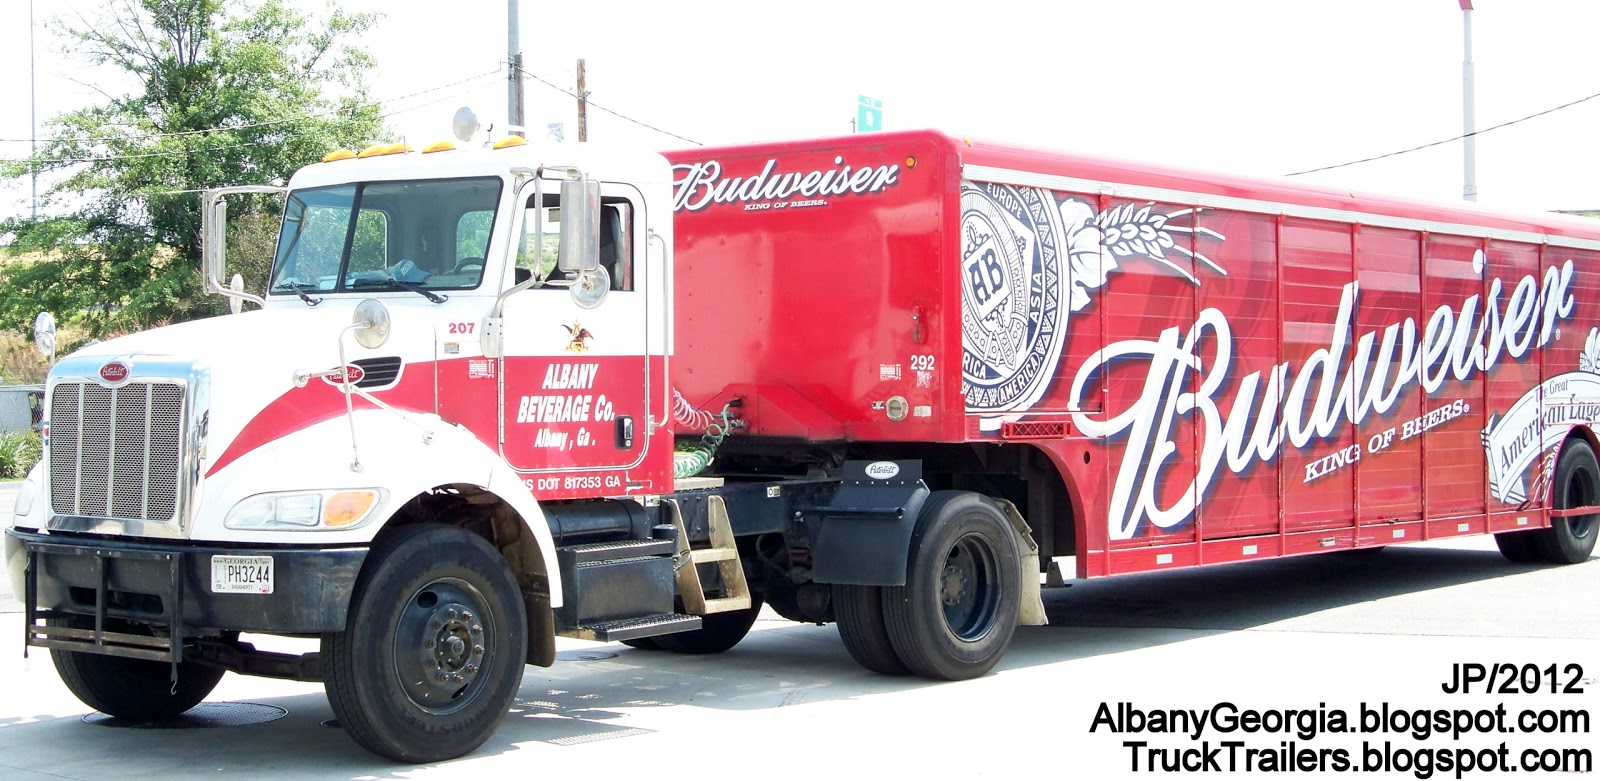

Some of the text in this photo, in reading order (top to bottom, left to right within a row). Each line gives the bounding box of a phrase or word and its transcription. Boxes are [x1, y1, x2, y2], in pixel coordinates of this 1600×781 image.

[673, 156, 899, 212] Budweiser
[986, 183, 1023, 219] EUROPE
[1029, 272, 1043, 324] ASIA
[449, 322, 475, 334] 207
[910, 355, 934, 370] 292
[542, 363, 599, 390] ALBANY
[999, 356, 1038, 403] AMERICA
[1550, 379, 1568, 394] Great
[517, 394, 615, 423] BEVERAGE Co.
[534, 428, 568, 451] Albany
[1302, 444, 1361, 484] KING
[1368, 428, 1396, 454] OF
[520, 475, 621, 490] S DOT 817353 GA
[228, 565, 269, 583] PH3244
